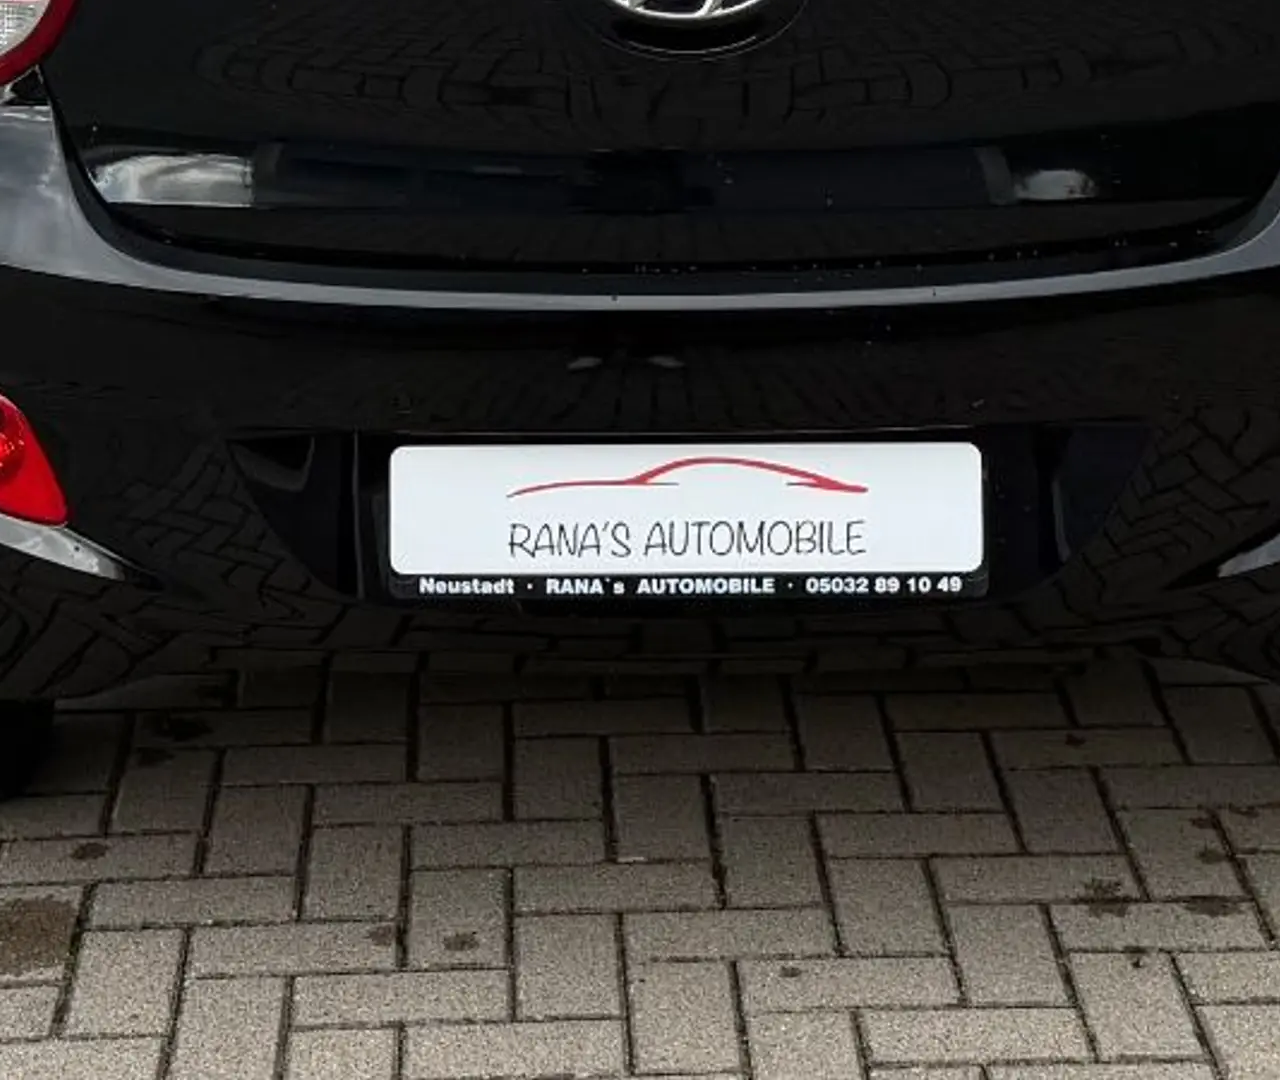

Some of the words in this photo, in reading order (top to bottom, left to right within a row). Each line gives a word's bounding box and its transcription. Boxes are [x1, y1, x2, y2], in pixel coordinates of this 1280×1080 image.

[508, 520, 632, 559] RANA'S
[643, 519, 868, 557] AUTOMOBILE
[419, 577, 515, 595] Neustadt
[636, 576, 776, 595] AUTOMOBILE
[805, 576, 869, 594] 05032
[874, 576, 901, 594] 89
[907, 576, 932, 594] 10
[937, 576, 963, 594] 49
